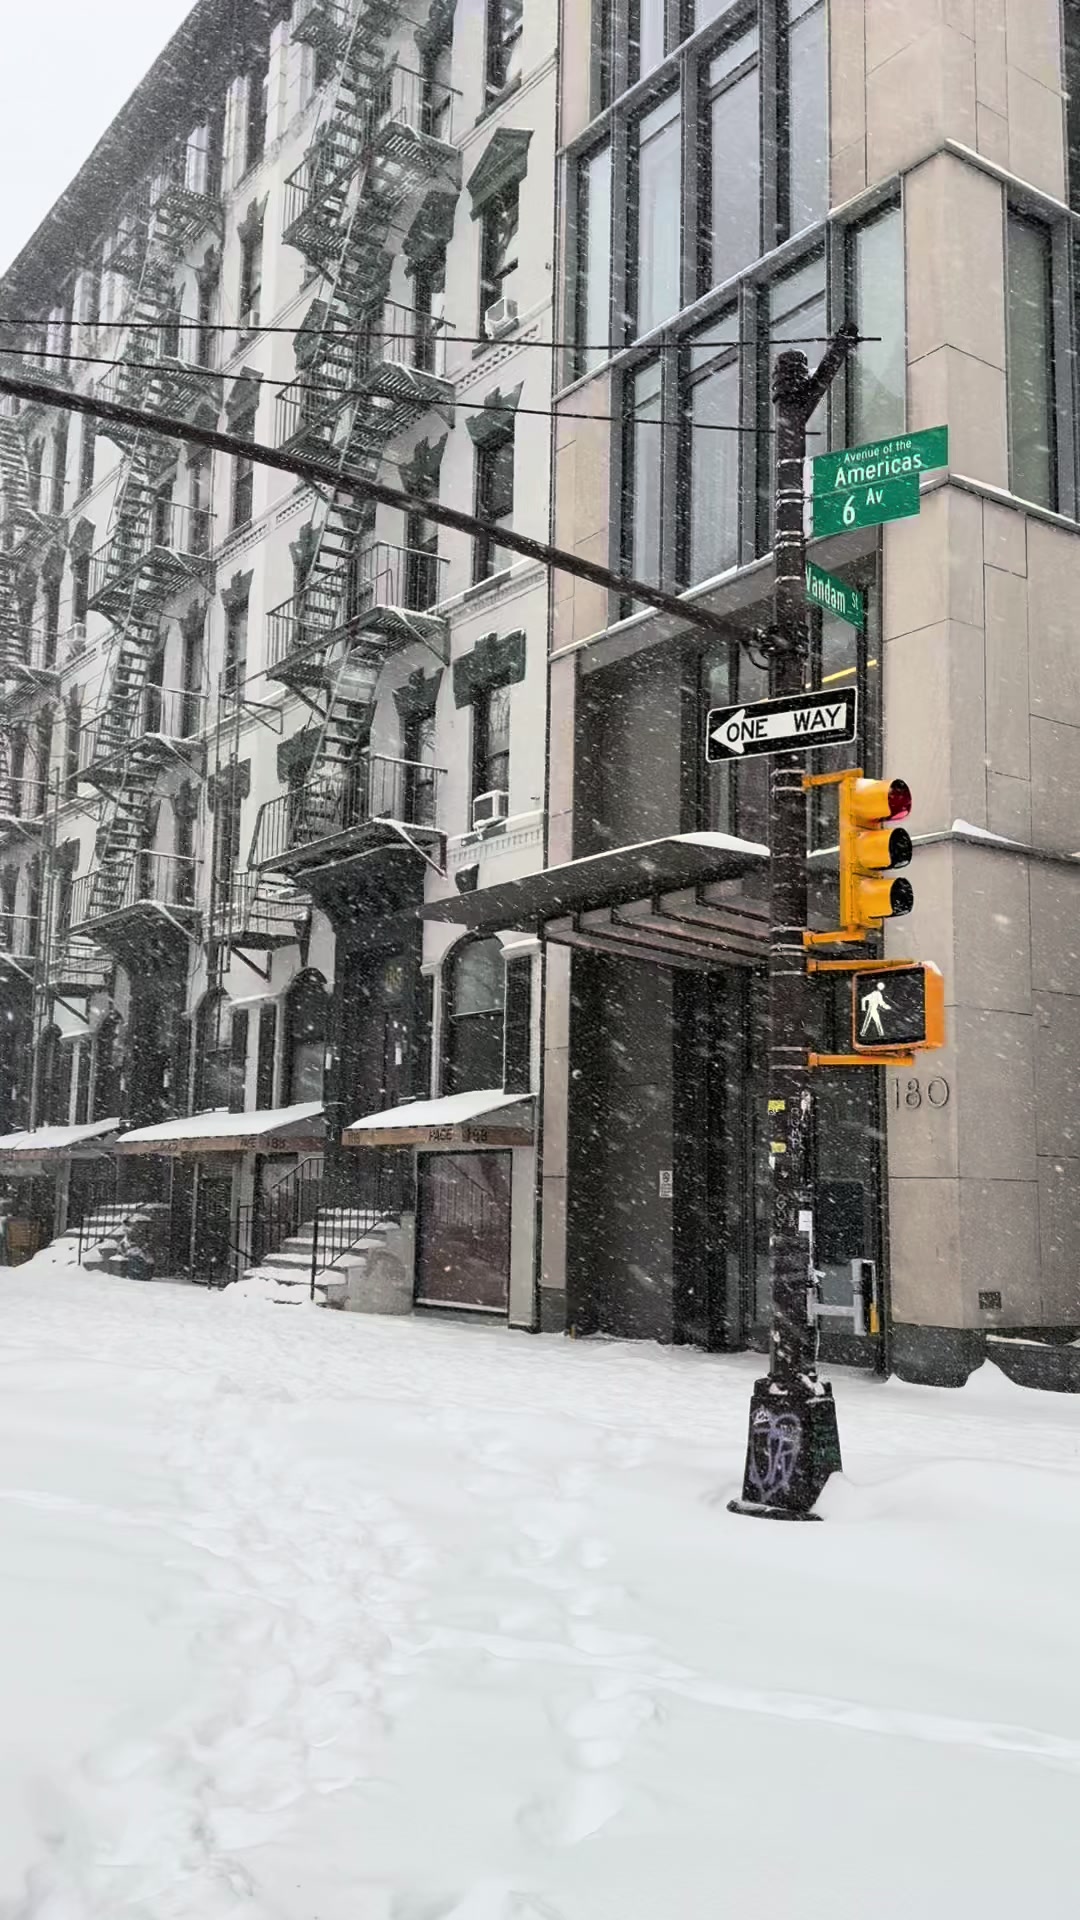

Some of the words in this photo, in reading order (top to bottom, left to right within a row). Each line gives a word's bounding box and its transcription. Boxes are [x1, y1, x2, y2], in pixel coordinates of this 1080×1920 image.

[844, 447, 879, 464] Avenue
[883, 443, 893, 454] of
[896, 439, 912, 451] the
[834, 453, 922, 488] Americas
[843, 495, 856, 525] 6
[866, 488, 884, 505] Av
[805, 567, 846, 614] Vandam
[851, 591, 859, 610] St
[726, 718, 768, 742] ONE
[794, 706, 842, 732] WAY
[891, 1076, 950, 1111] 180
